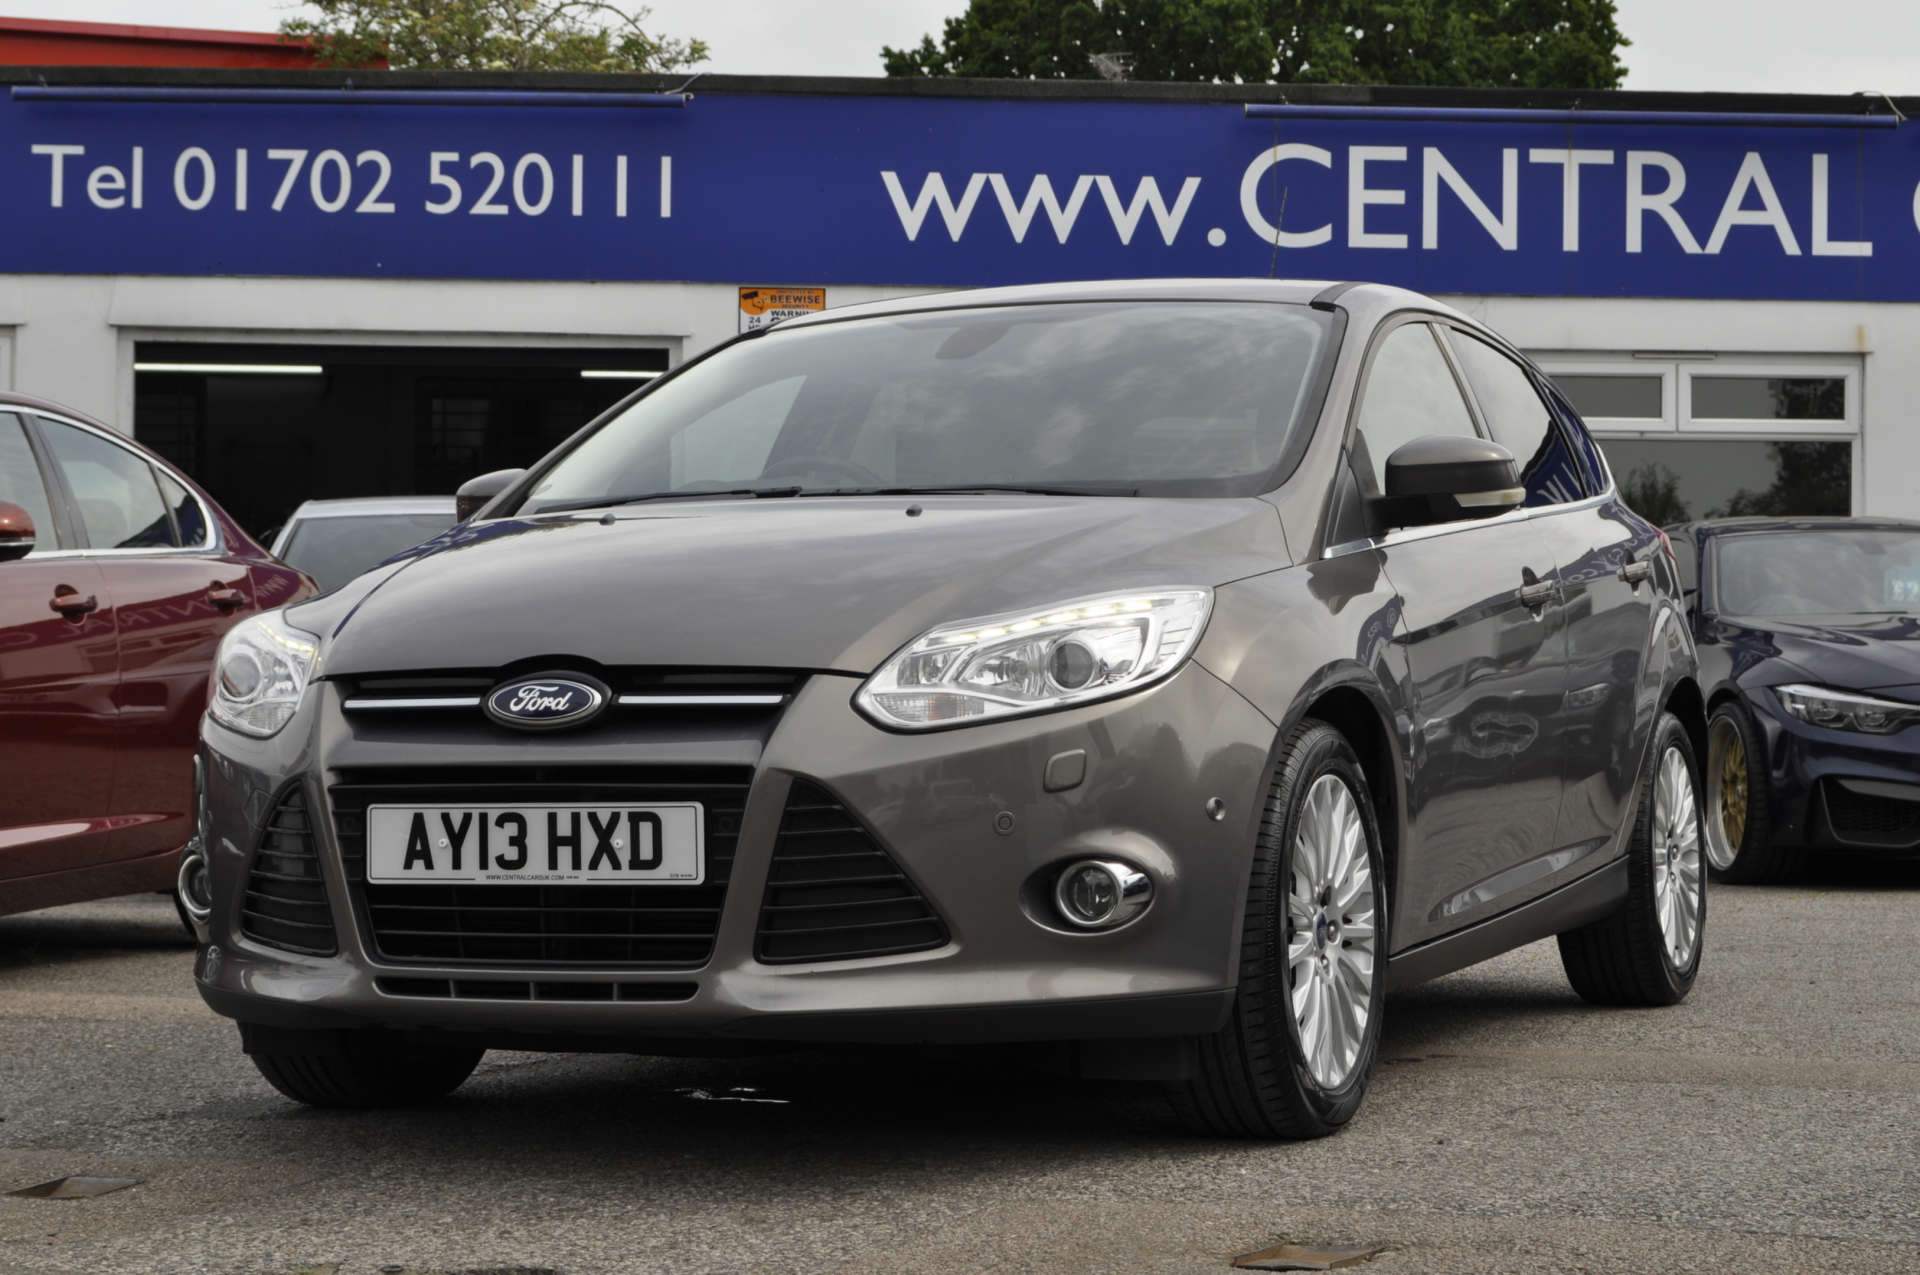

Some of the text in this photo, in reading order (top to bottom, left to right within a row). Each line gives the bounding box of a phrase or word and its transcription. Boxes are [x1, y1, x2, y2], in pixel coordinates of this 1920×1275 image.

[31, 144, 673, 218] Tel 01702 520111
[769, 295, 821, 304] BEEWISE
[510, 685, 572, 712] Ford
[403, 811, 663, 871] AY13 HXD
